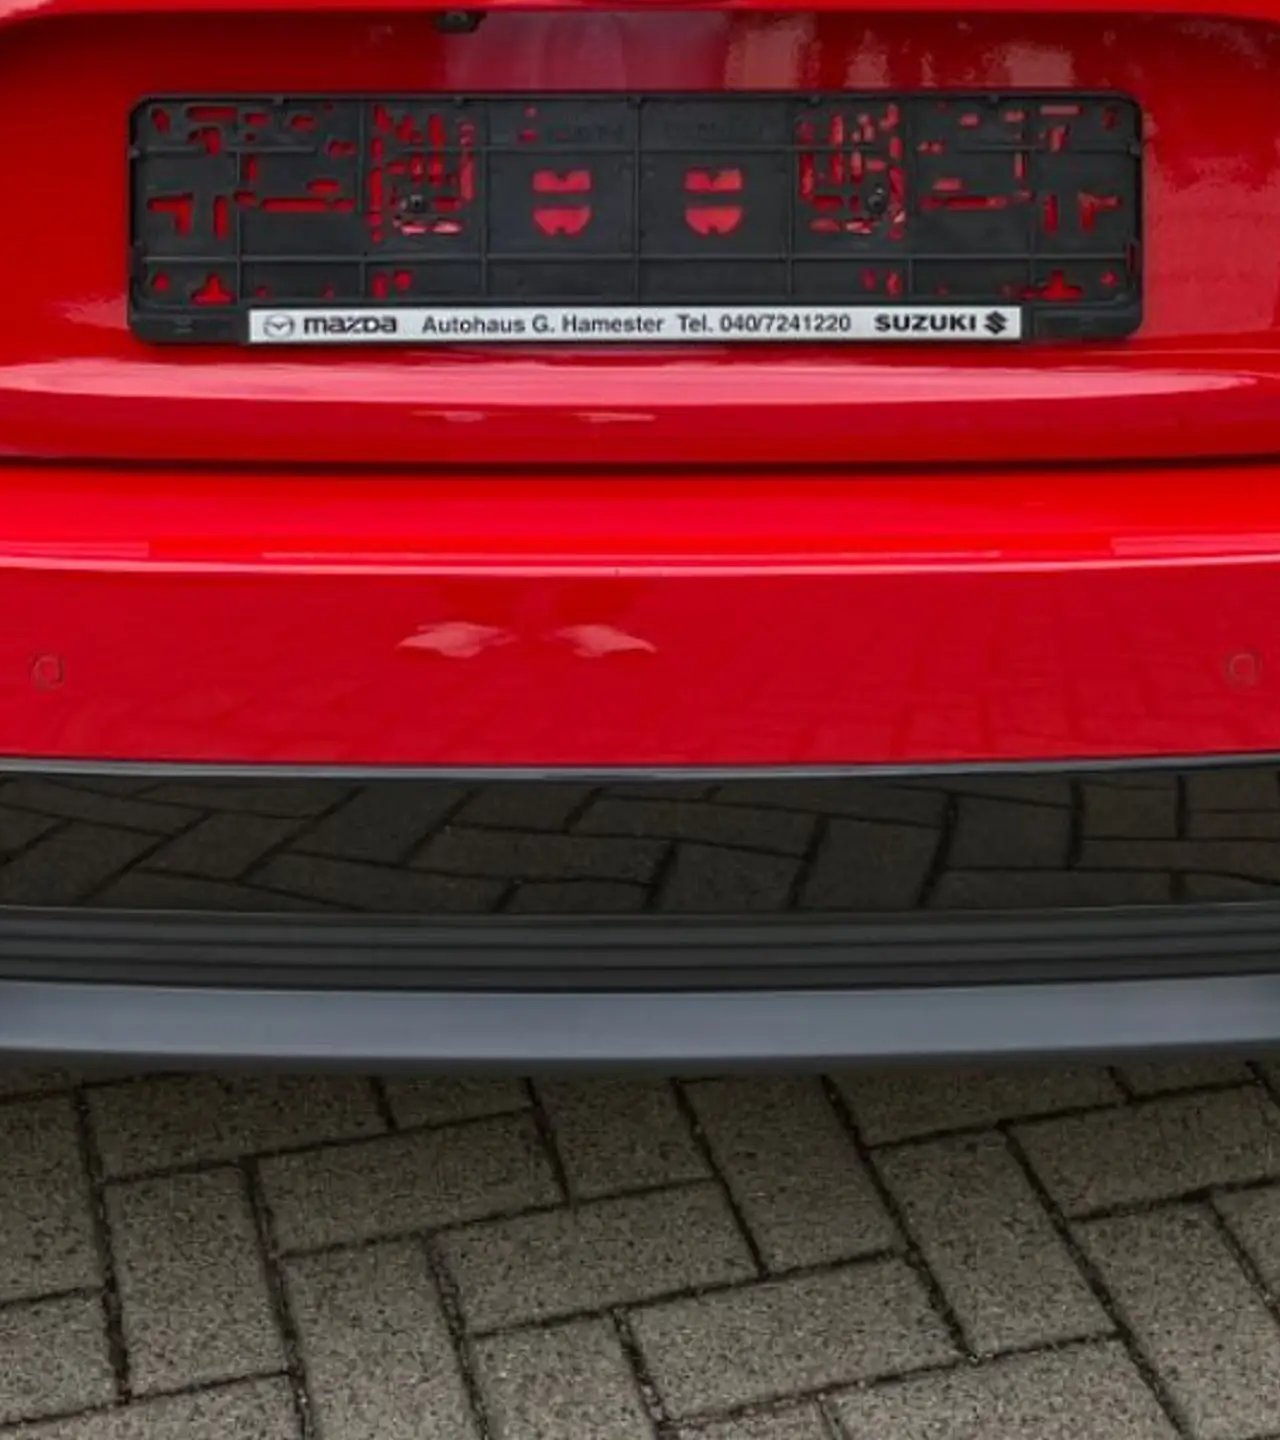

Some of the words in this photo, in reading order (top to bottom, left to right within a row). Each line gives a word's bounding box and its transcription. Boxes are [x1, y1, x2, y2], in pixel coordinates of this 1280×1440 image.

[422, 314, 526, 335] Autohaus
[532, 315, 555, 334] G.
[562, 314, 664, 334] Hamester
[678, 314, 713, 333] Tel.
[719, 313, 852, 333] 040/7241220
[874, 313, 977, 333] SUZUKI
